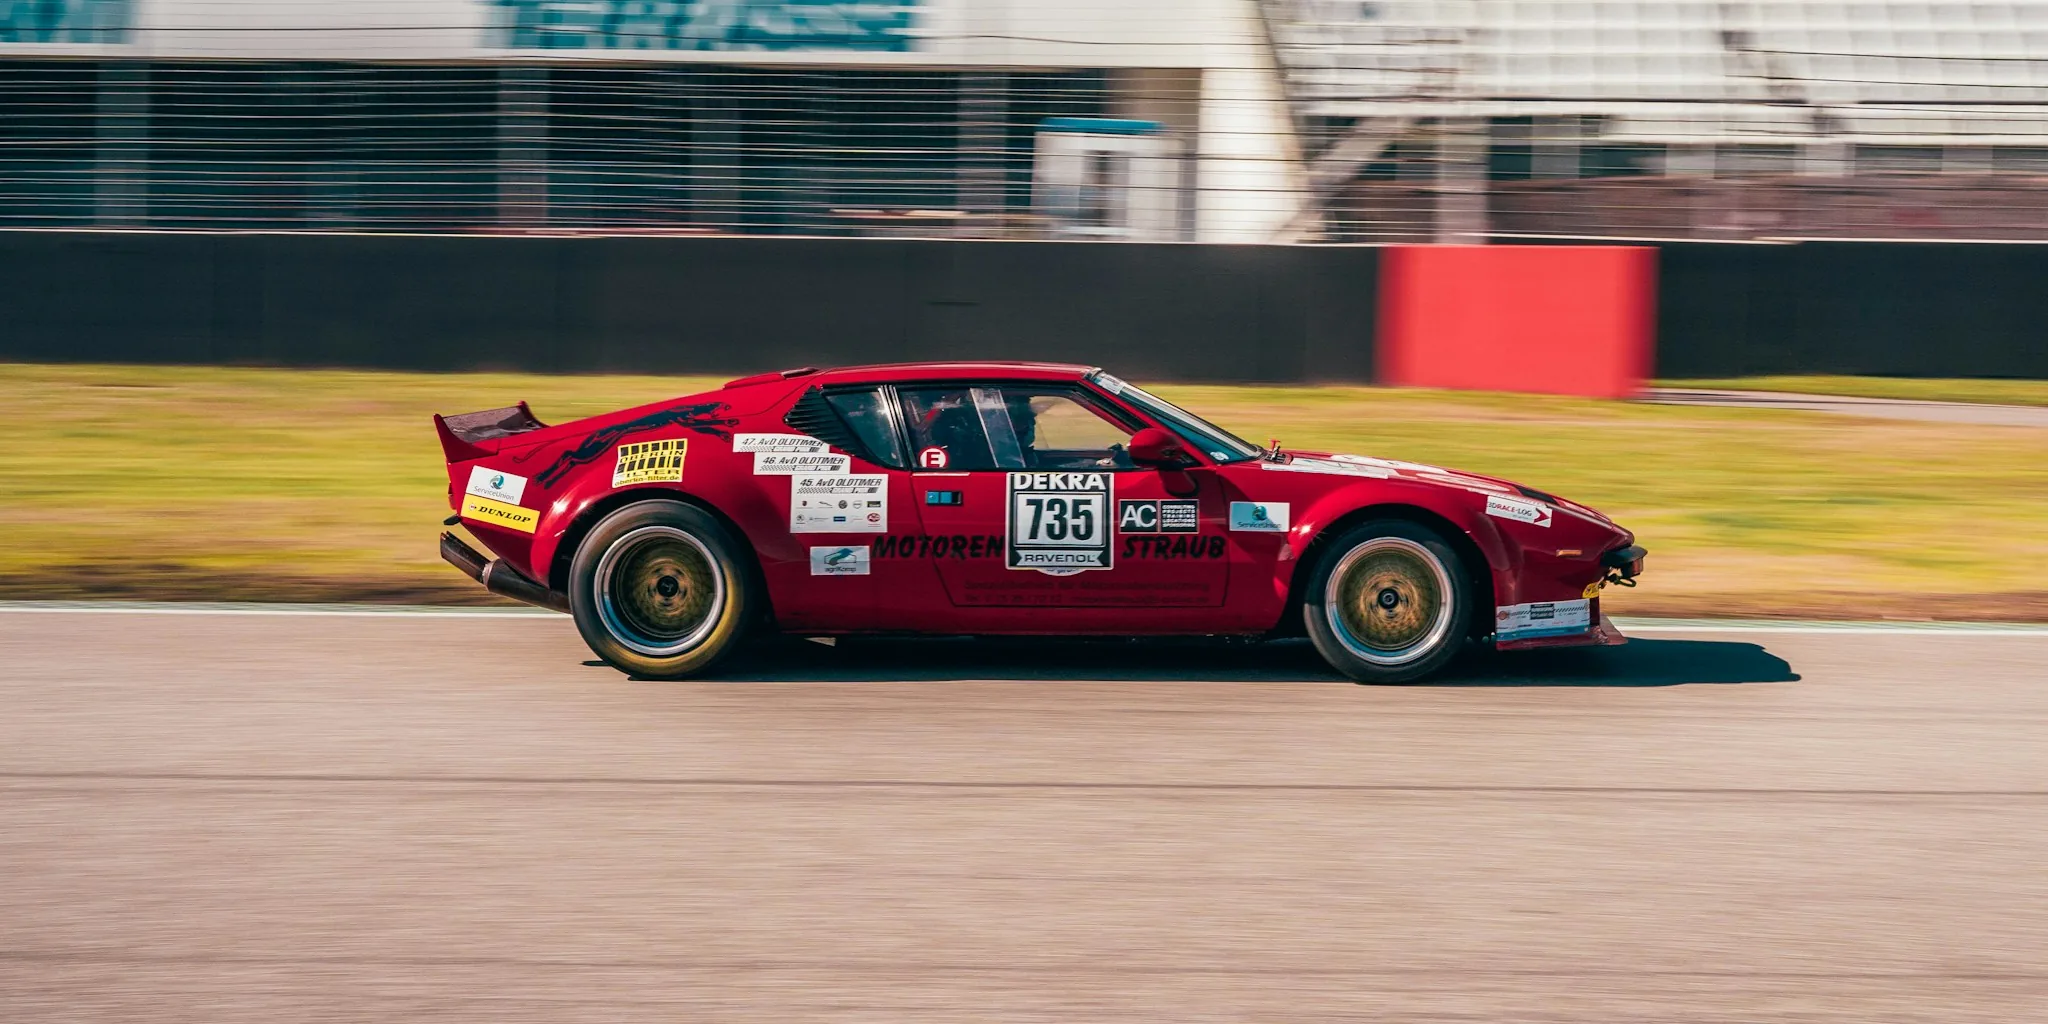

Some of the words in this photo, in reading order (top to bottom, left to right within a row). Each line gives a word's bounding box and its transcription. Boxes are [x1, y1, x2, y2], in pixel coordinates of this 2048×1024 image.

[742, 438, 756, 446] 47.
[759, 438, 777, 446] AvD
[763, 457, 777, 465] 46.
[780, 457, 798, 465] AvD
[799, 457, 845, 465] OLDTIMER
[926, 452, 941, 468] E
[800, 479, 814, 487] 45.
[817, 478, 835, 487] AvD
[836, 478, 882, 487] OLDTIMER
[1014, 473, 1106, 490] DEKRA
[474, 485, 514, 501] ServiceUnion
[478, 505, 531, 524] DUNLOP
[1026, 498, 1094, 541] 735
[1120, 504, 1157, 527] AC
[872, 535, 1005, 560] MOTOREN
[1122, 535, 1226, 560] STRAUB
[1024, 554, 1095, 563] RAVENOL
